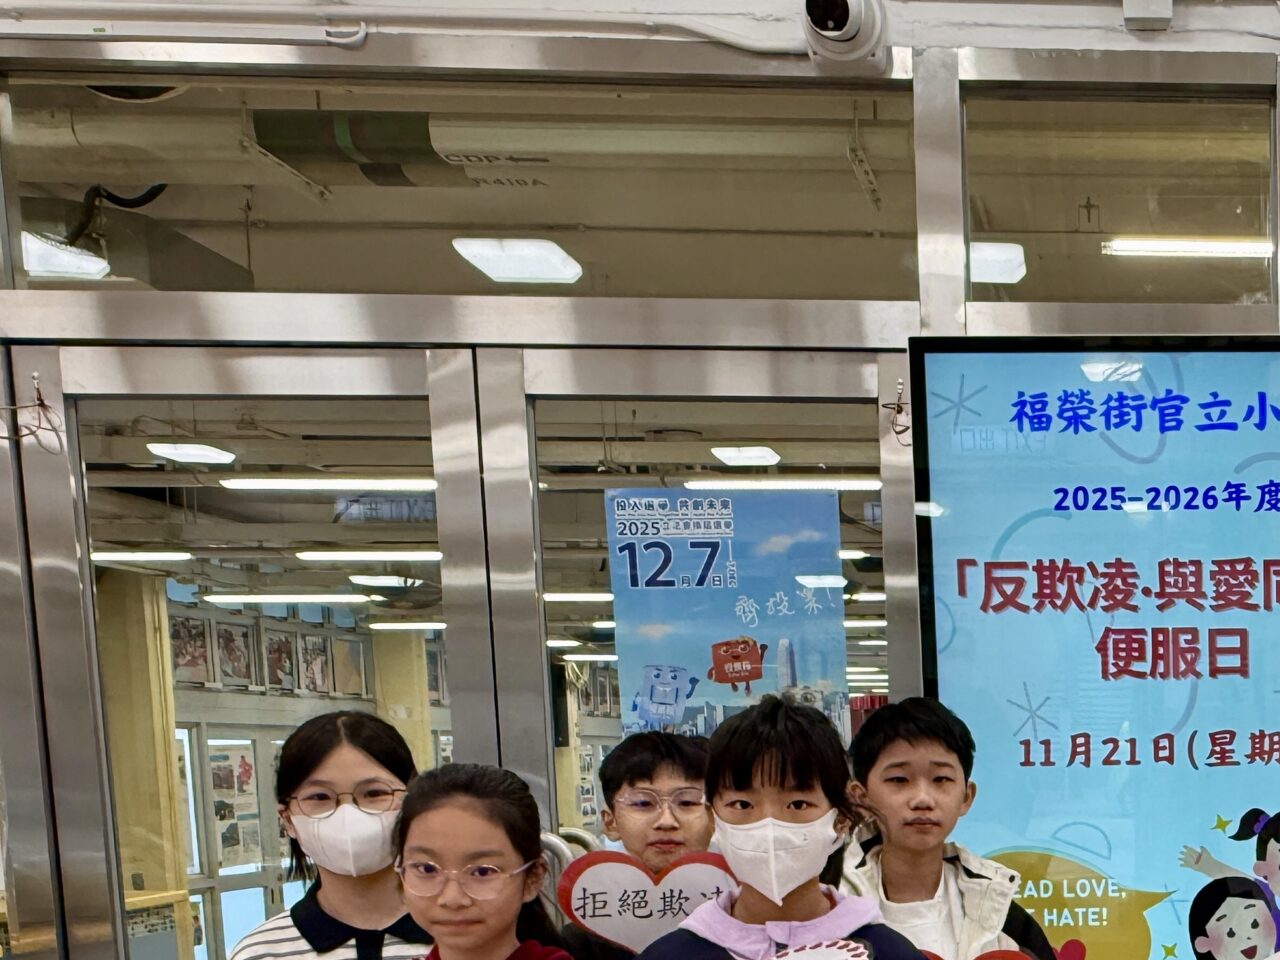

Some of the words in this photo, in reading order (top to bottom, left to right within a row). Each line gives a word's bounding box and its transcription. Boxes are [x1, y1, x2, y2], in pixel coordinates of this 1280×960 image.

[618, 521, 660, 536] 2025
[1095, 627, 1251, 681] 便服日
[1063, 878, 1127, 899] LOVE,
[1044, 908, 1108, 927] HATE!
